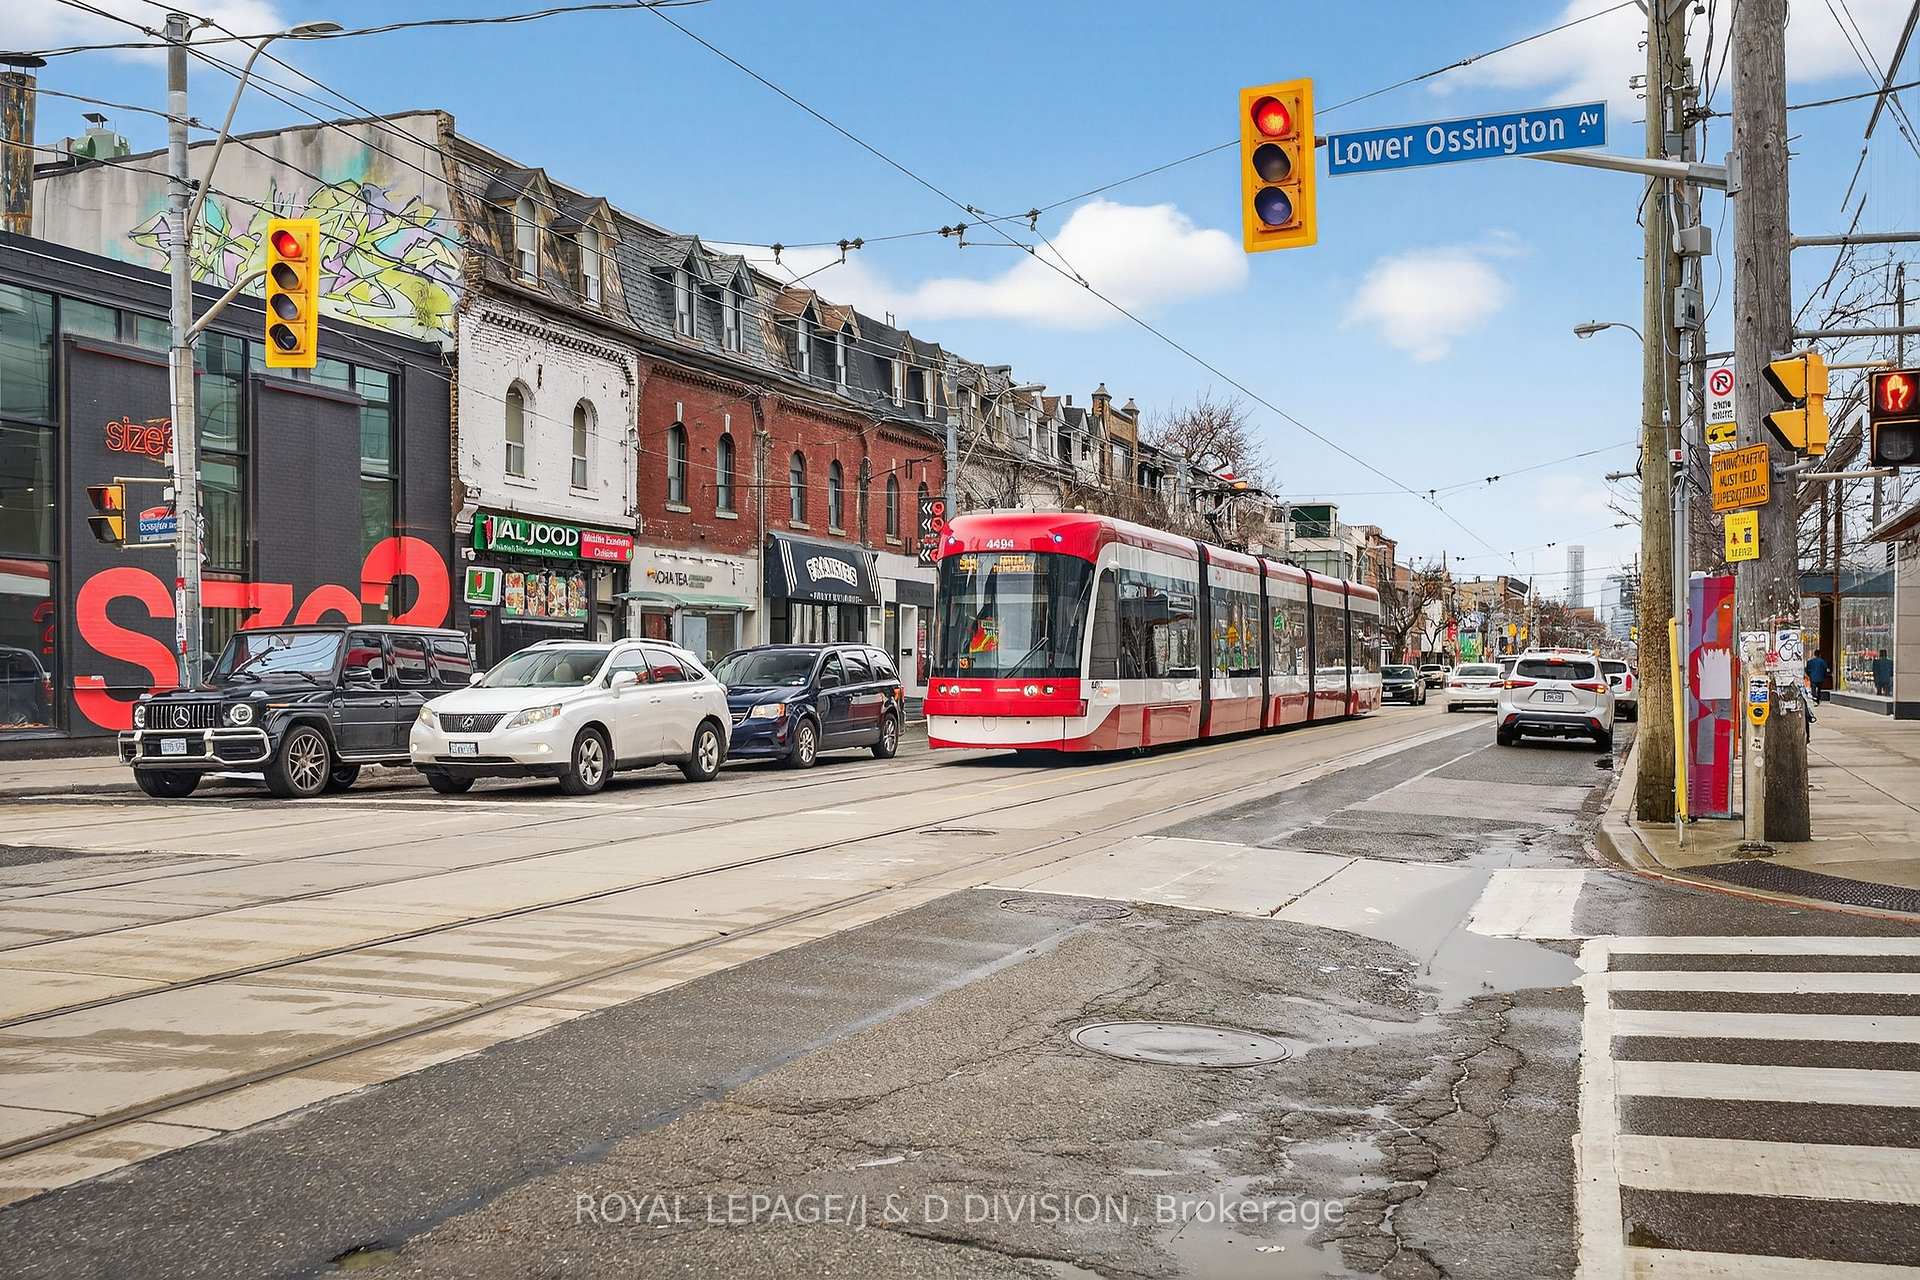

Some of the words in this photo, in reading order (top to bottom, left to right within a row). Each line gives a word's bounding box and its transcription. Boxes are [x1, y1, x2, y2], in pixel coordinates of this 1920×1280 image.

[1334, 134, 1413, 165] Lower
[1426, 116, 1565, 154] Ossington
[527, 523, 579, 547] JOOD
[986, 538, 1014, 550] 4494
[675, 572, 689, 586] TEA
